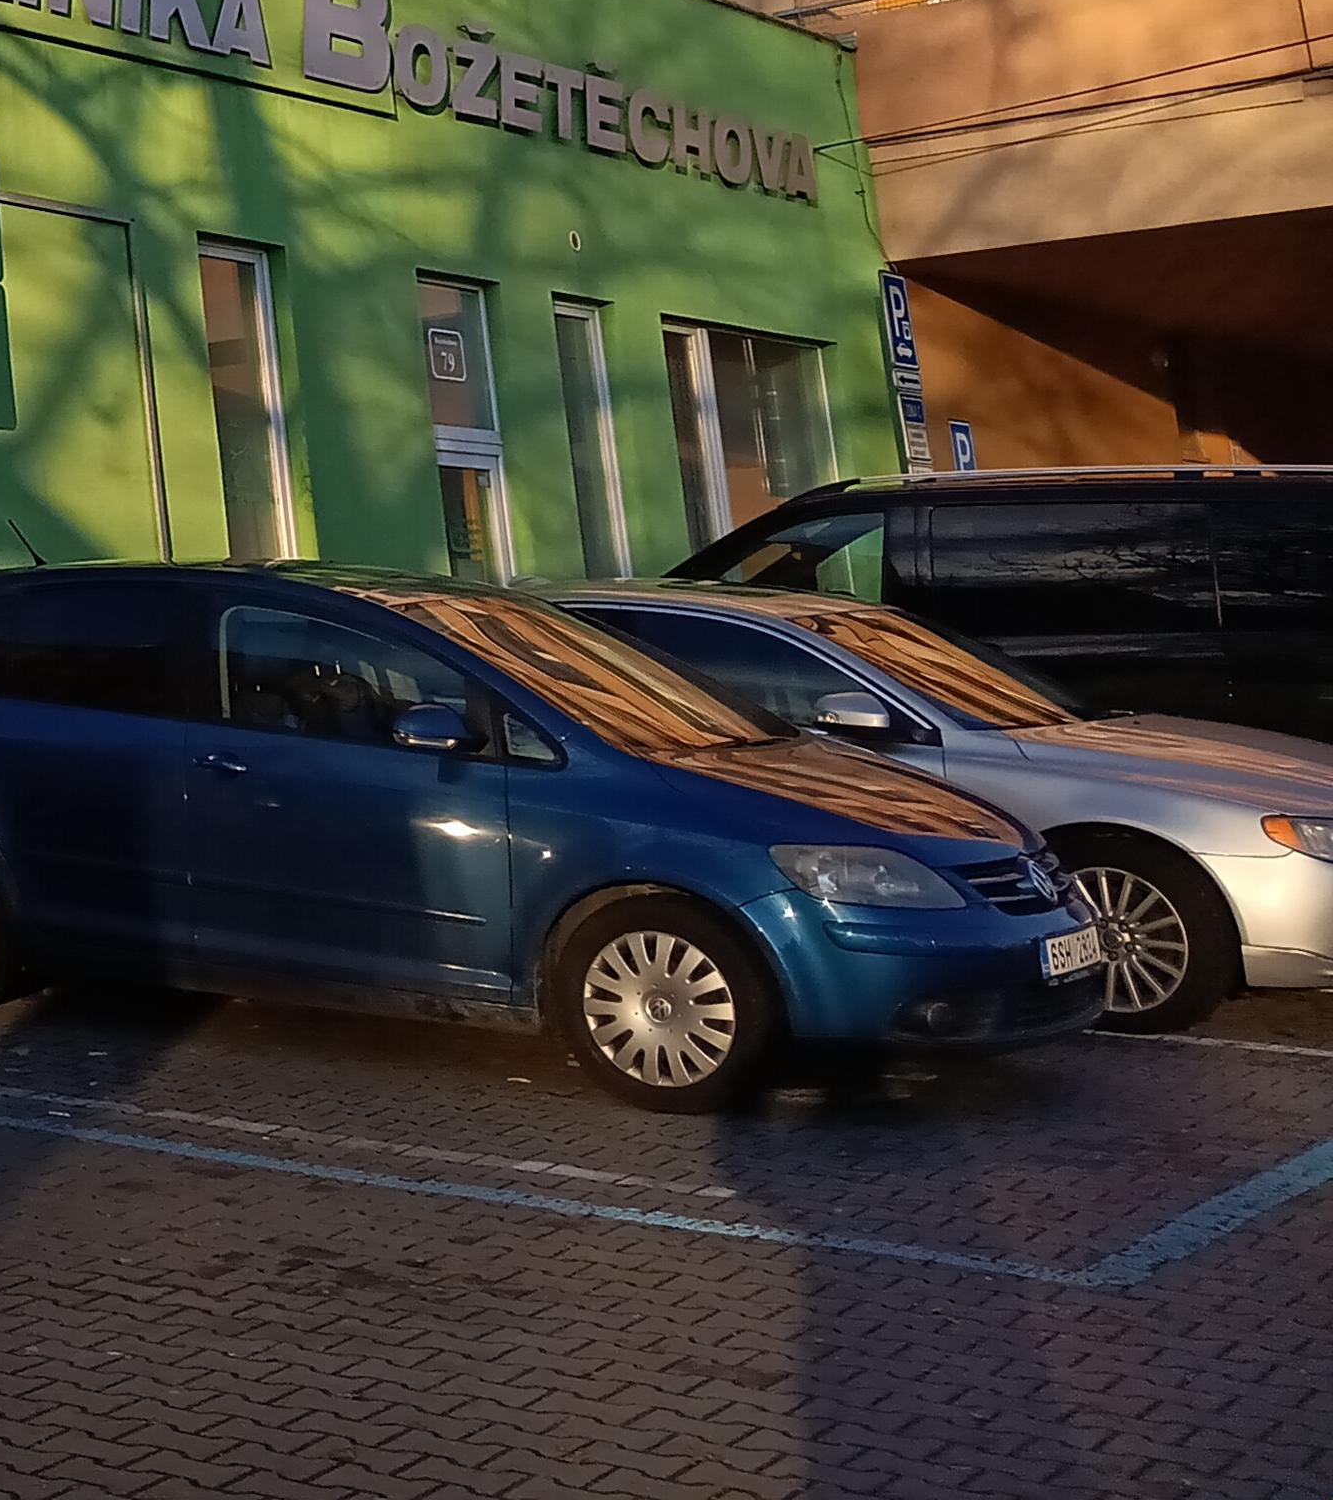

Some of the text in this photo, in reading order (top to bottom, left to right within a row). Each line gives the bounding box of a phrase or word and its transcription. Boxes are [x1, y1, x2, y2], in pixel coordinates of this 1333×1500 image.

[889, 285, 905, 338] P
[440, 351, 455, 372] 79
[955, 432, 971, 471] P
[1051, 938, 1073, 970] 6SH
